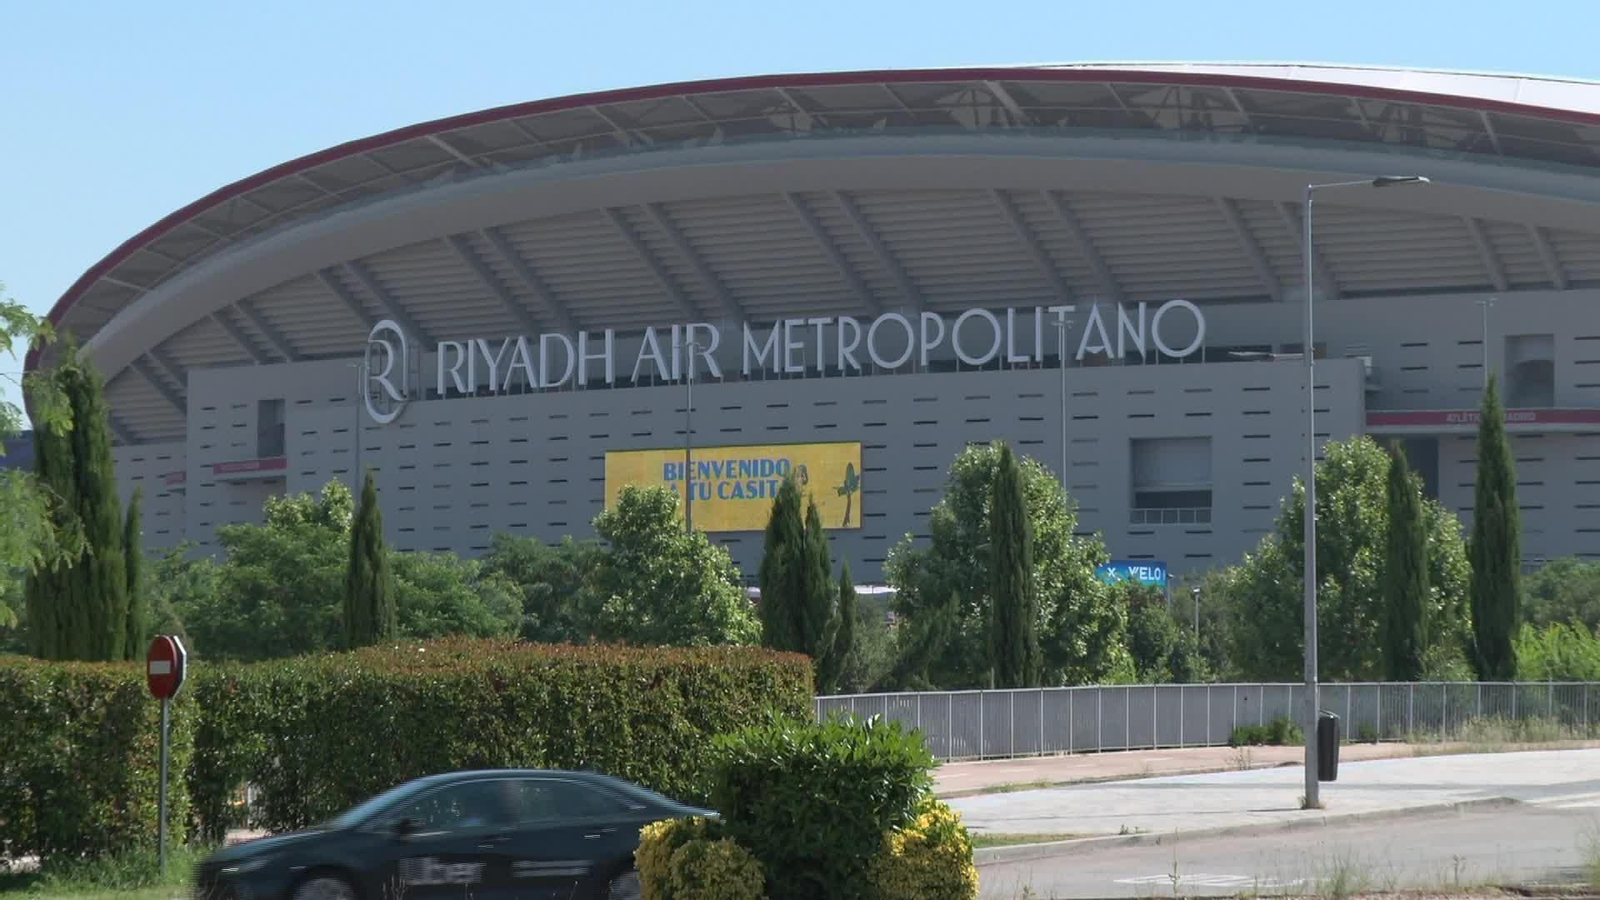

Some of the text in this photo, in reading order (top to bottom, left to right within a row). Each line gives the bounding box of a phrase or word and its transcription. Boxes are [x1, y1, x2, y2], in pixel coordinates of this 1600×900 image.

[437, 299, 1206, 395] RIYADH AIR METROPOLITANO
[663, 458, 791, 481] BIENVENIDO
[688, 481, 712, 501] TU
[717, 480, 779, 500] CASIT
